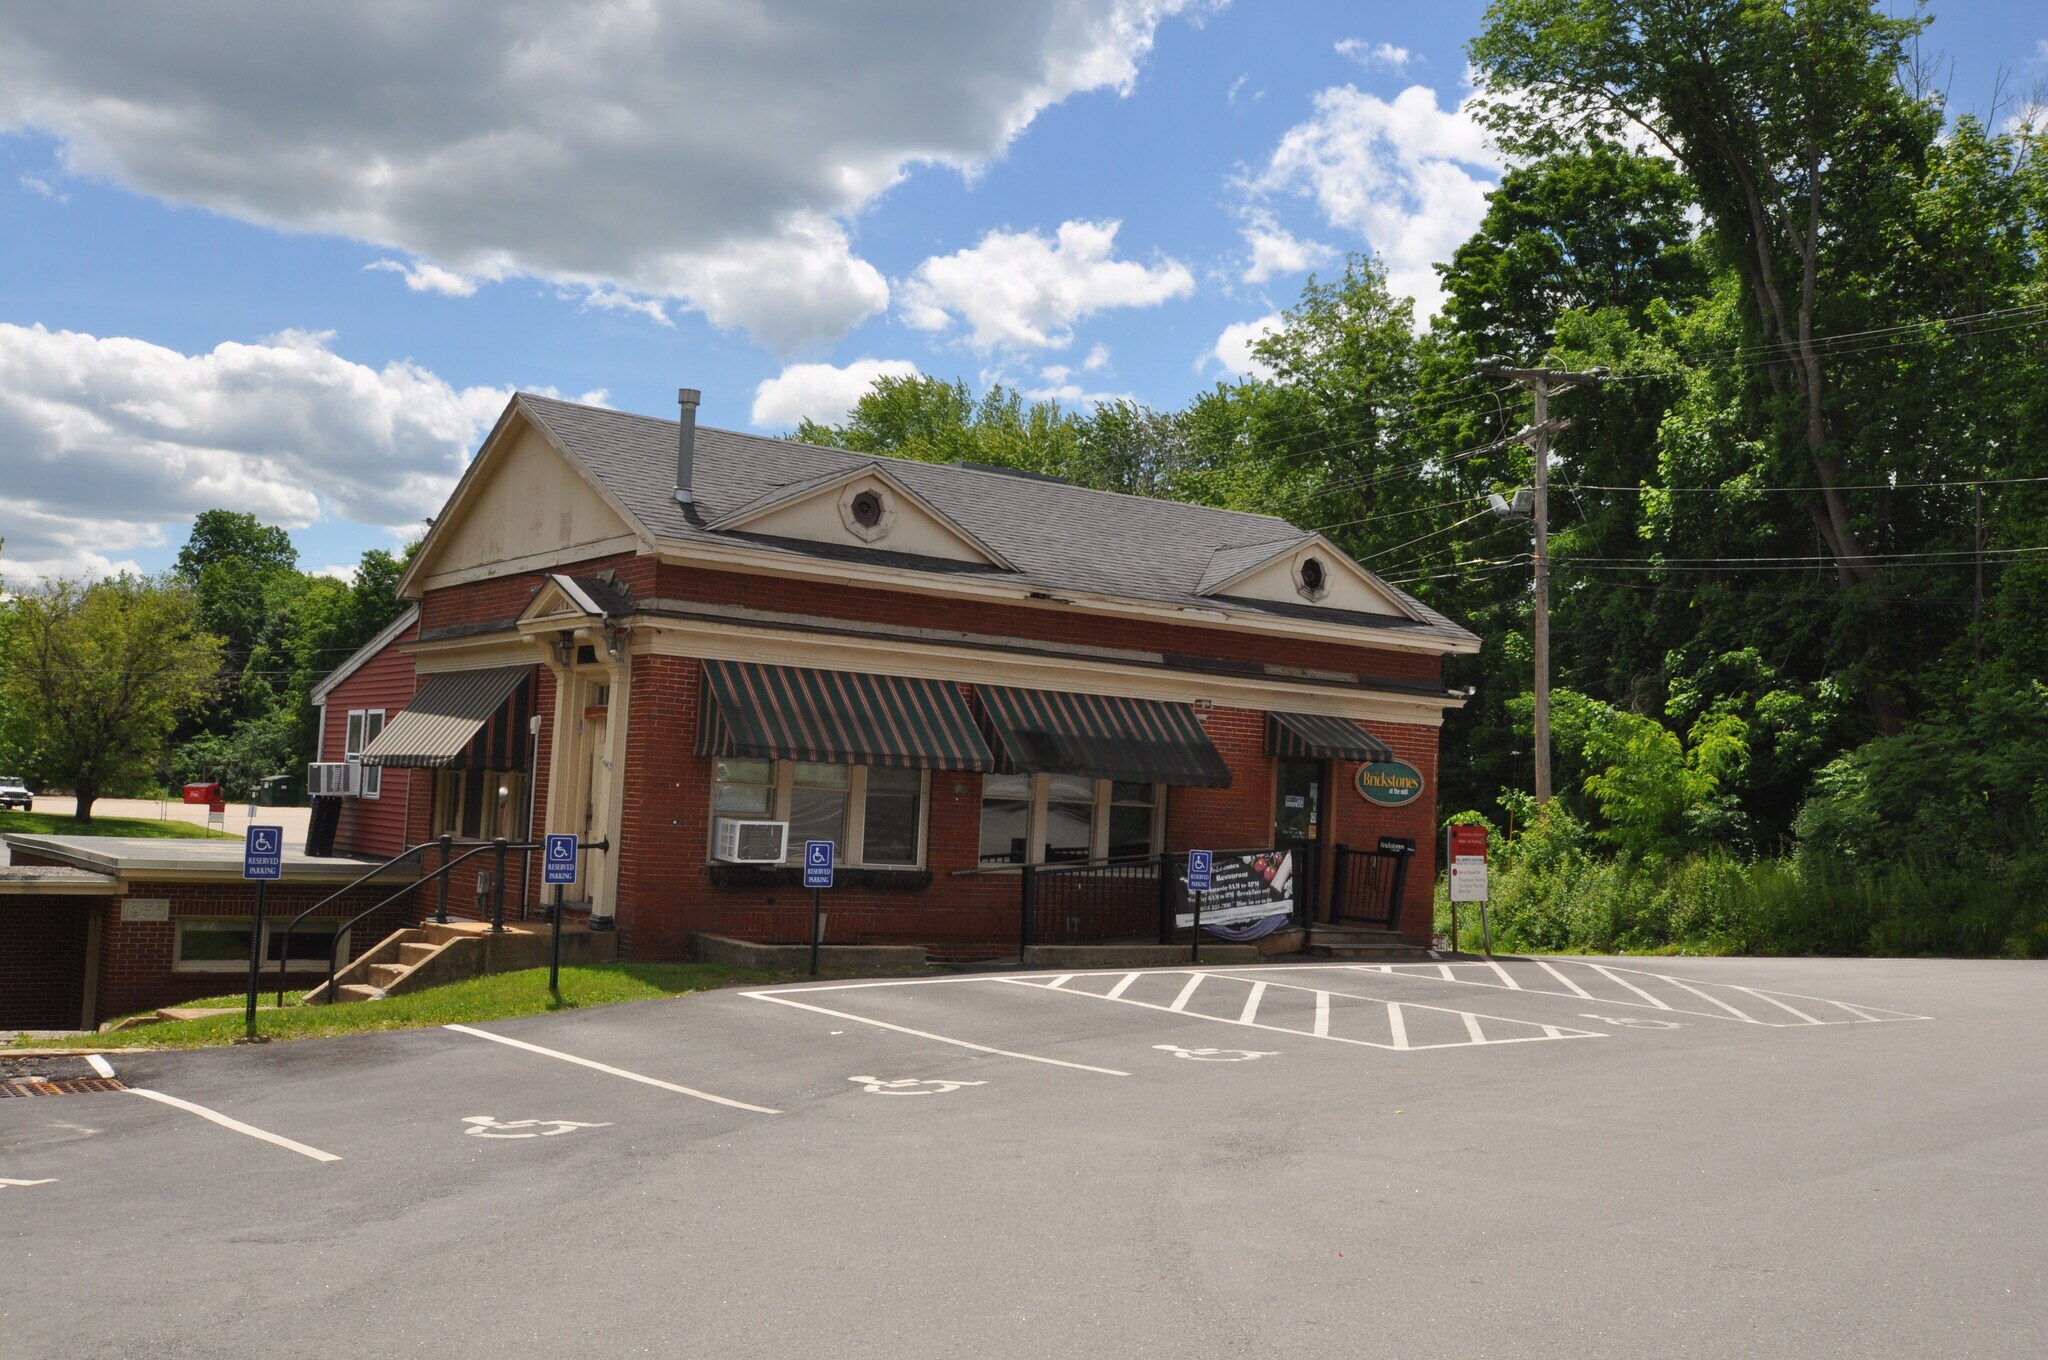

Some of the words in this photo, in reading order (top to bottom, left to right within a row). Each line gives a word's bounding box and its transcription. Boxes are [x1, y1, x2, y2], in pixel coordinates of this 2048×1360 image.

[1363, 771, 1418, 789] Brickstones
[1380, 842, 1404, 850] Brickstones
[248, 857, 279, 865] RESERVED
[249, 867, 275, 875] PARKING
[1216, 872, 1248, 881] Restaurant
[125, 903, 164, 918] 1955
